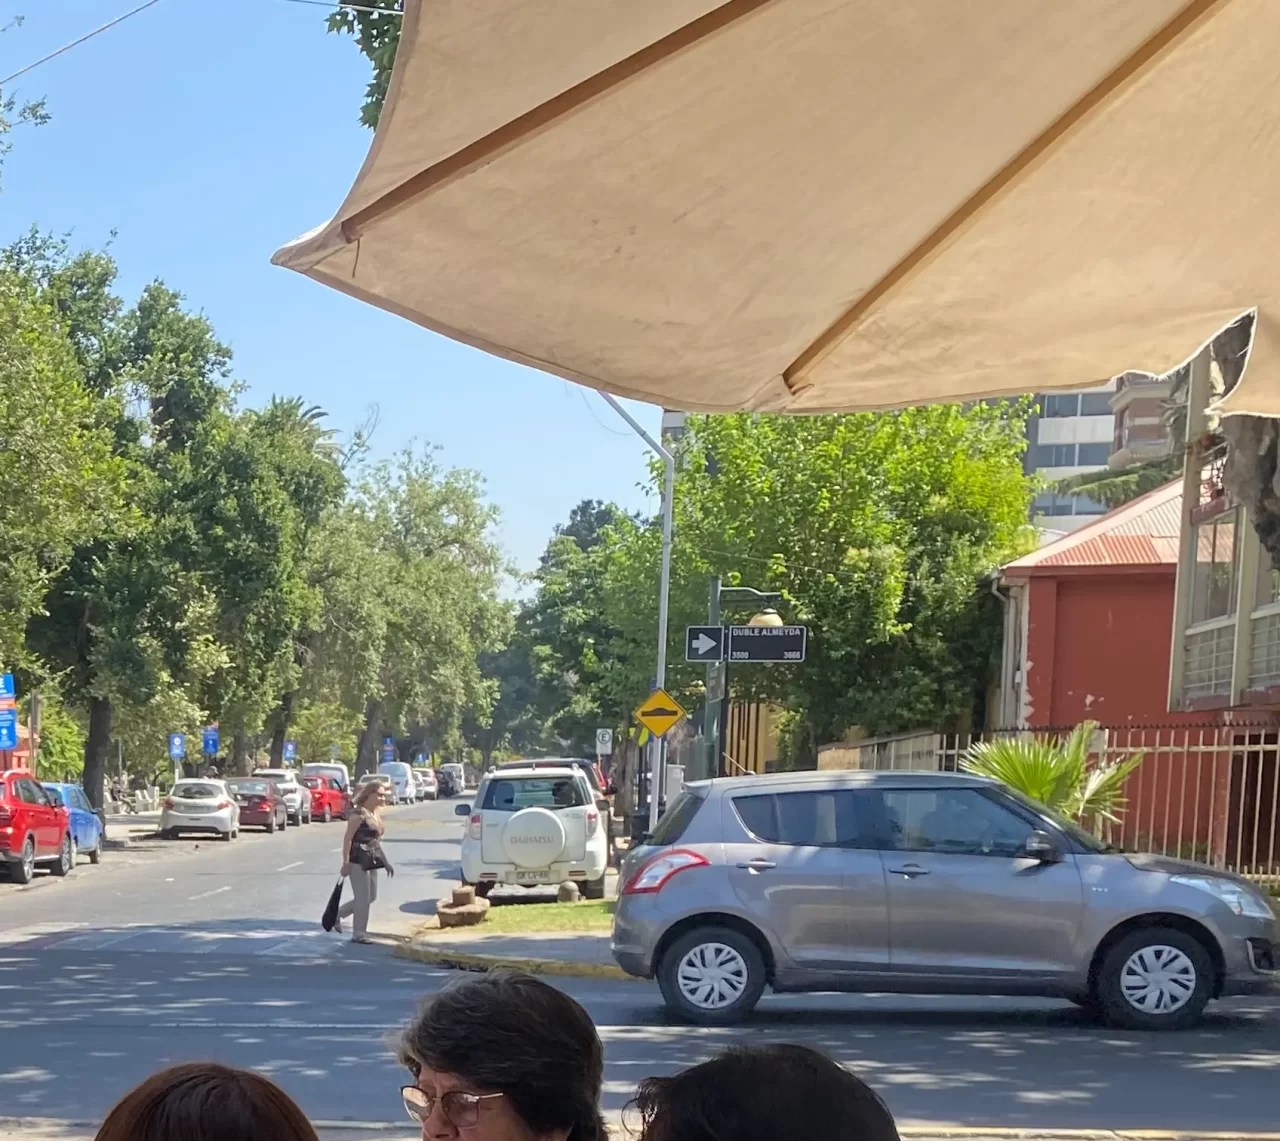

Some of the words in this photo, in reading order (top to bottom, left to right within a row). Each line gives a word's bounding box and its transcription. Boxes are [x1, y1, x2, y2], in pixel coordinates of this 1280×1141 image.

[733, 628, 760, 636] DUBLE
[762, 628, 800, 636] ALMEYDA
[601, 733, 607, 741] E
[511, 836, 554, 844] DAIHATSU
